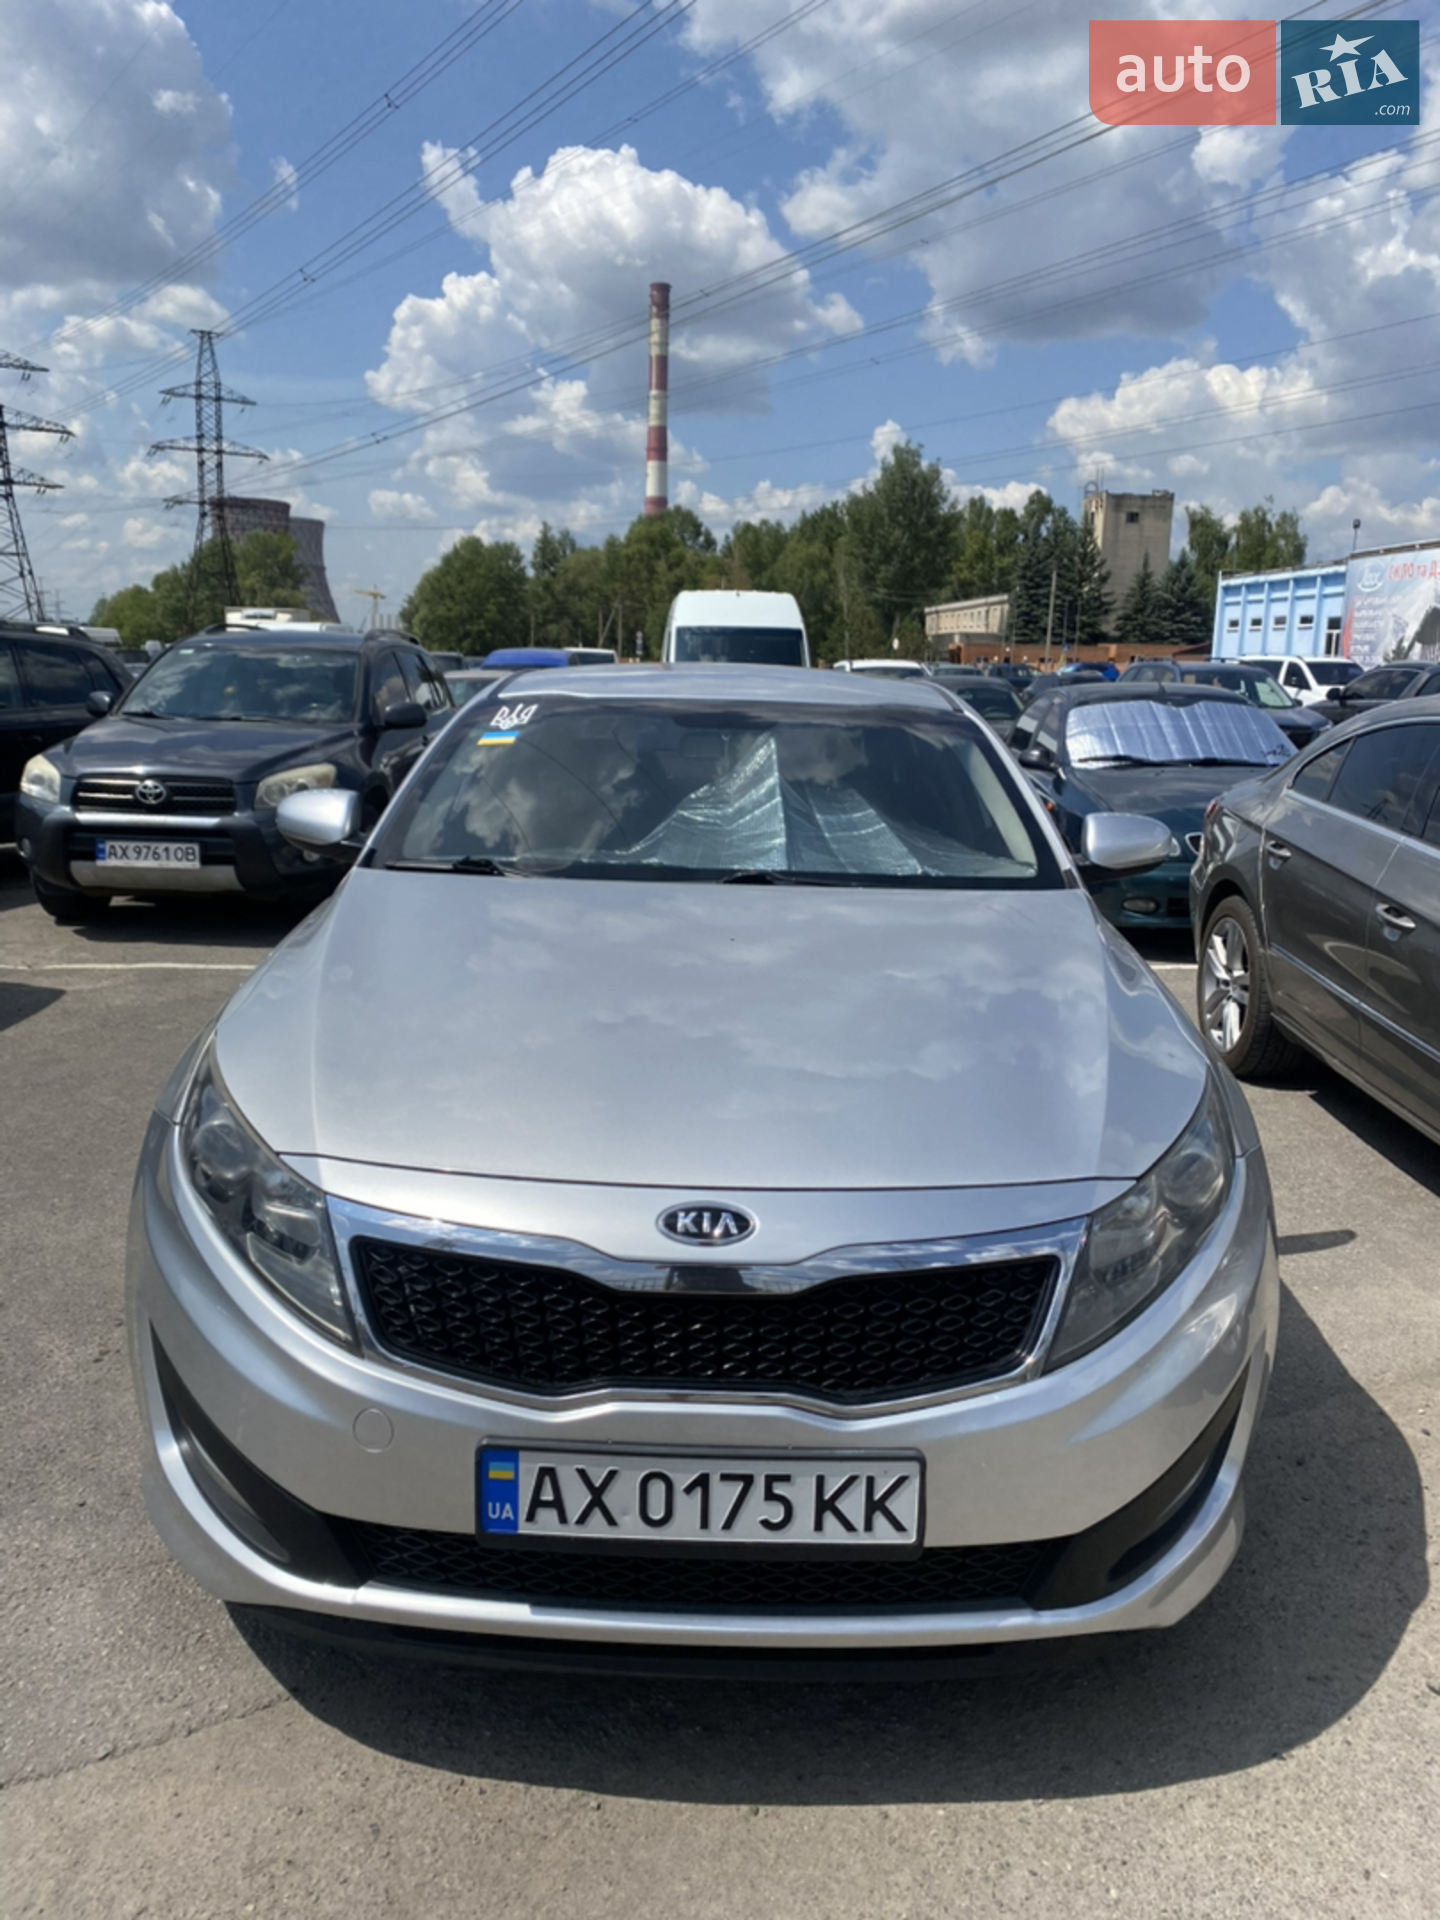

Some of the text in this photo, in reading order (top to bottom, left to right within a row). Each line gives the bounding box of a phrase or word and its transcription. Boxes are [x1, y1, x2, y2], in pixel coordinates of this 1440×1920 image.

[108, 844, 130, 860] AX
[132, 844, 170, 862] 9761
[676, 1211, 739, 1237] KIA
[487, 1501, 515, 1521] UA
[524, 1465, 911, 1534] AX 0175 KK
